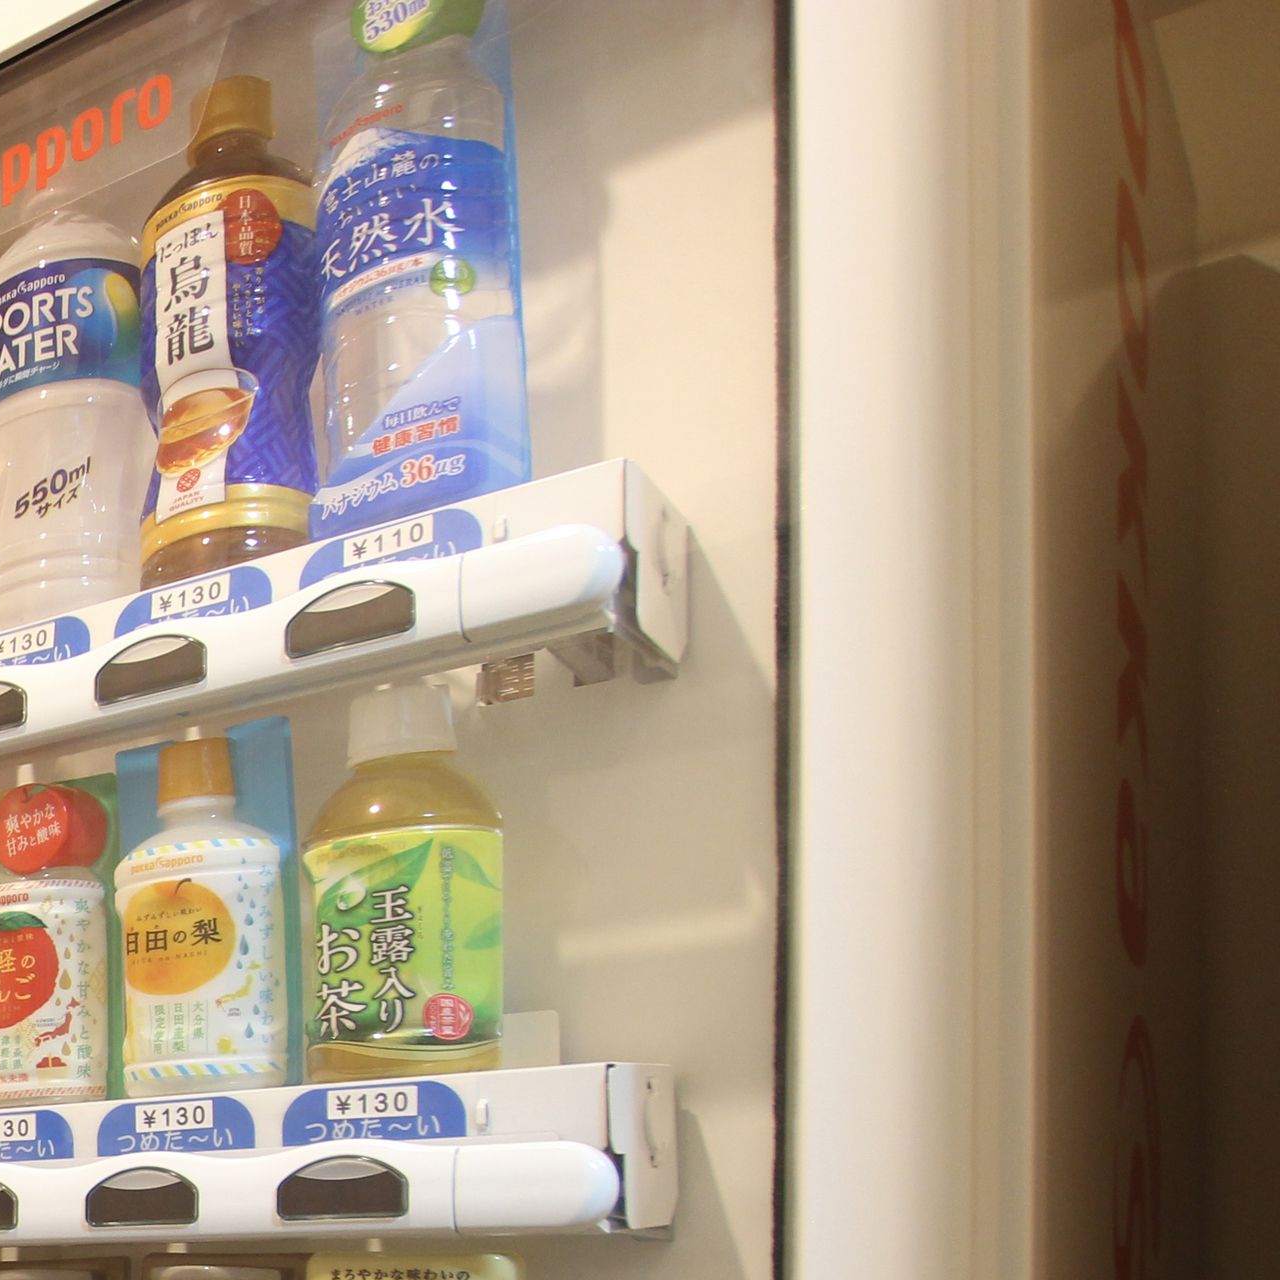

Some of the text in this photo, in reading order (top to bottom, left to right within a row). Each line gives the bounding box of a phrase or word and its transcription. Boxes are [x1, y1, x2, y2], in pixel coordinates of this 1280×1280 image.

[160, 223, 220, 263] にっぽん
[239, 195, 254, 256] 日本品質
[321, 198, 465, 281] 天然水
[384, 397, 461, 429] 毎日飲んで
[372, 416, 459, 457] 健康習慣
[14, 456, 91, 520] 550ml
[36, 486, 81, 519] サイズ
[352, 522, 424, 559] ¥110
[159, 582, 221, 612] ¥130
[5, 803, 56, 835] 爽やかな
[5, 820, 62, 857] 甘みと酸味
[126, 918, 222, 956] 日田の梨
[369, 885, 416, 1034] 玉露入り
[314, 924, 368, 1041] お茶
[143, 1105, 207, 1128] ¥130
[335, 1091, 409, 1115] ¥130
